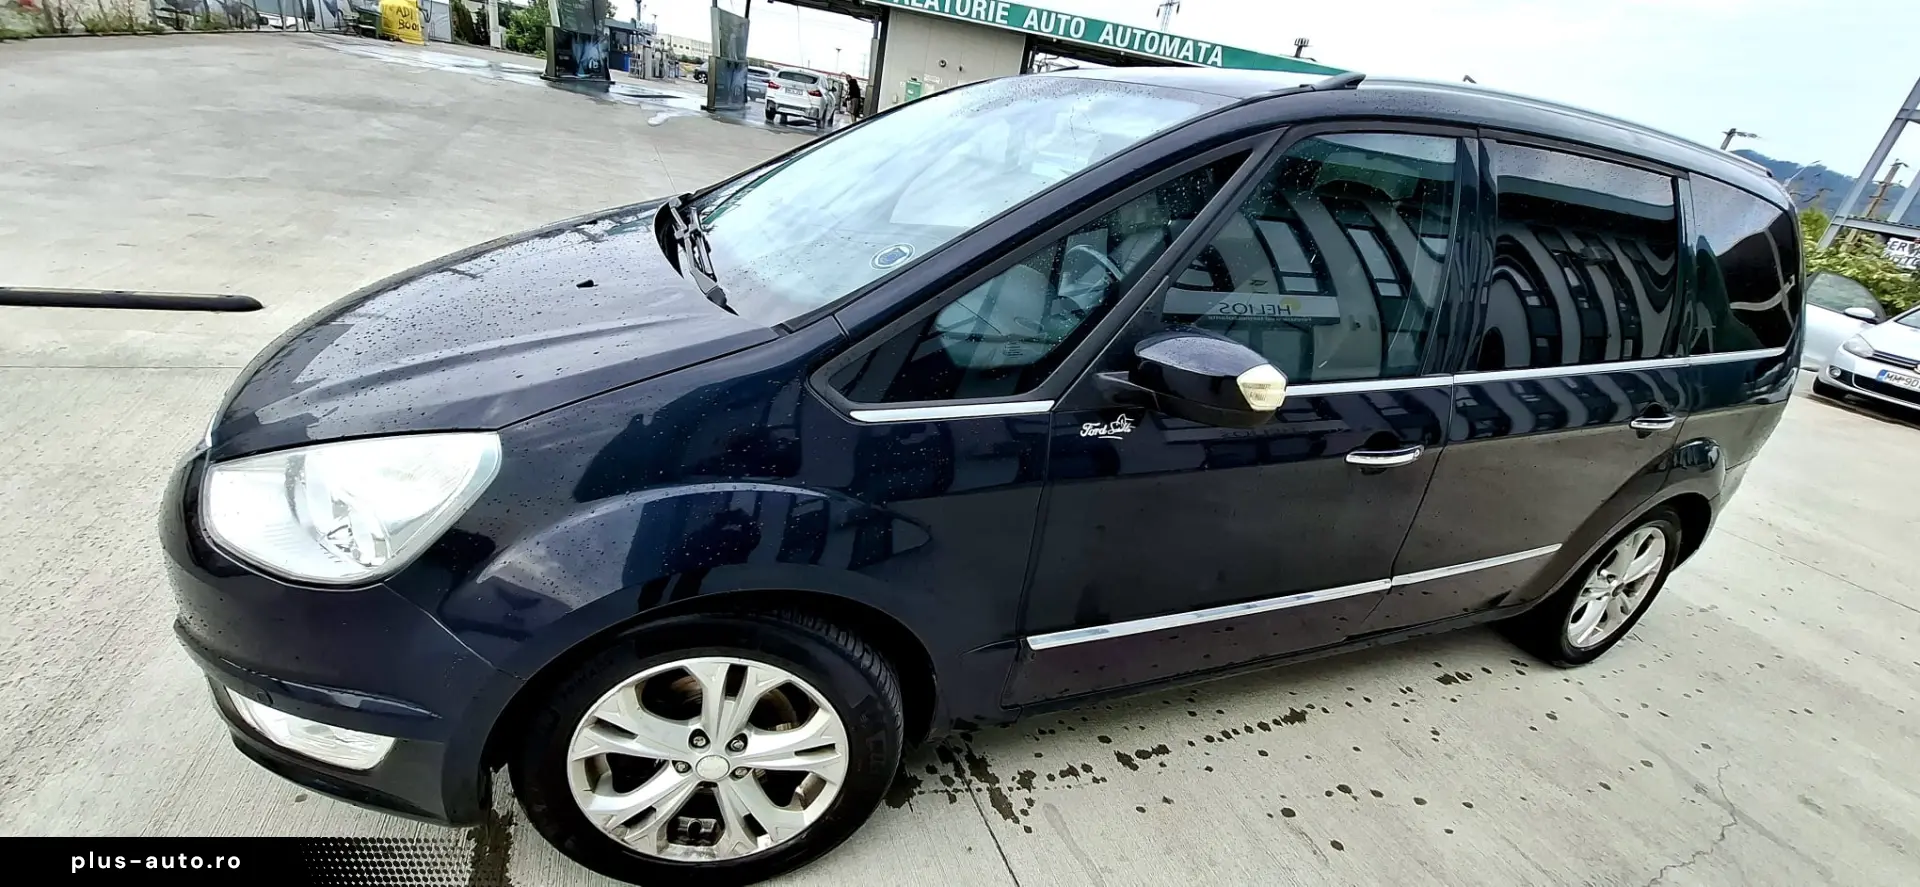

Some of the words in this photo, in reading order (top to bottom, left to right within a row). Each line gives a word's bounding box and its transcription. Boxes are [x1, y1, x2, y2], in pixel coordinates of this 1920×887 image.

[396, 6, 413, 20] ADI
[1023, 9, 1086, 39] AUTO
[1098, 23, 1223, 67] AUTOMATA
[1080, 422, 1107, 437] Ford
